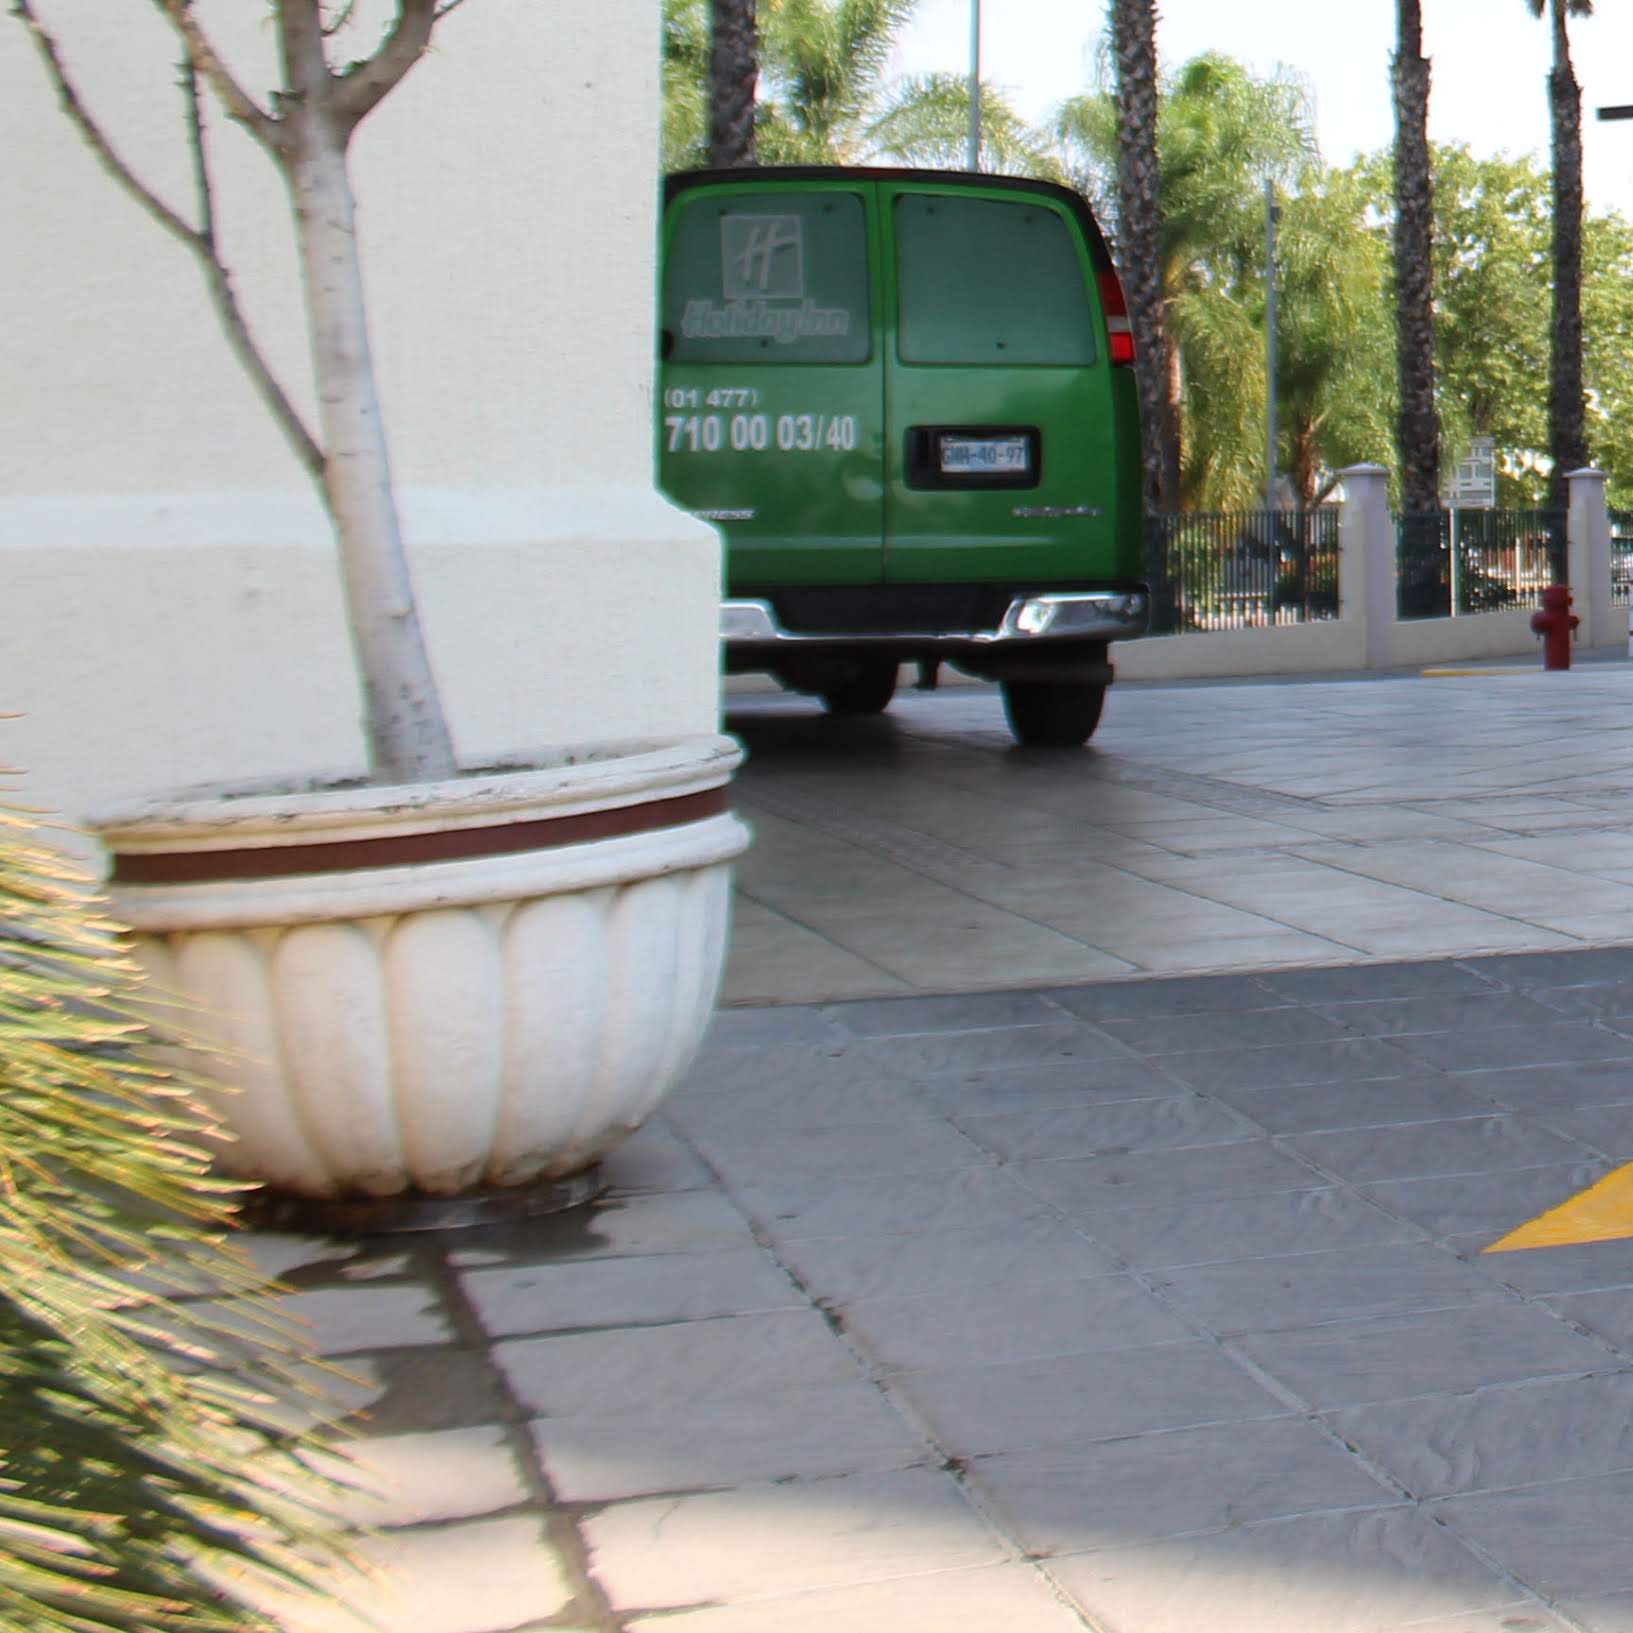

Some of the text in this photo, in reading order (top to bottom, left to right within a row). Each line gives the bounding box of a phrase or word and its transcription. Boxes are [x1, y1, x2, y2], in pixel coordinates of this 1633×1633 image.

[664, 388, 759, 409] (01 477)
[665, 414, 856, 452] 710 00 03/40
